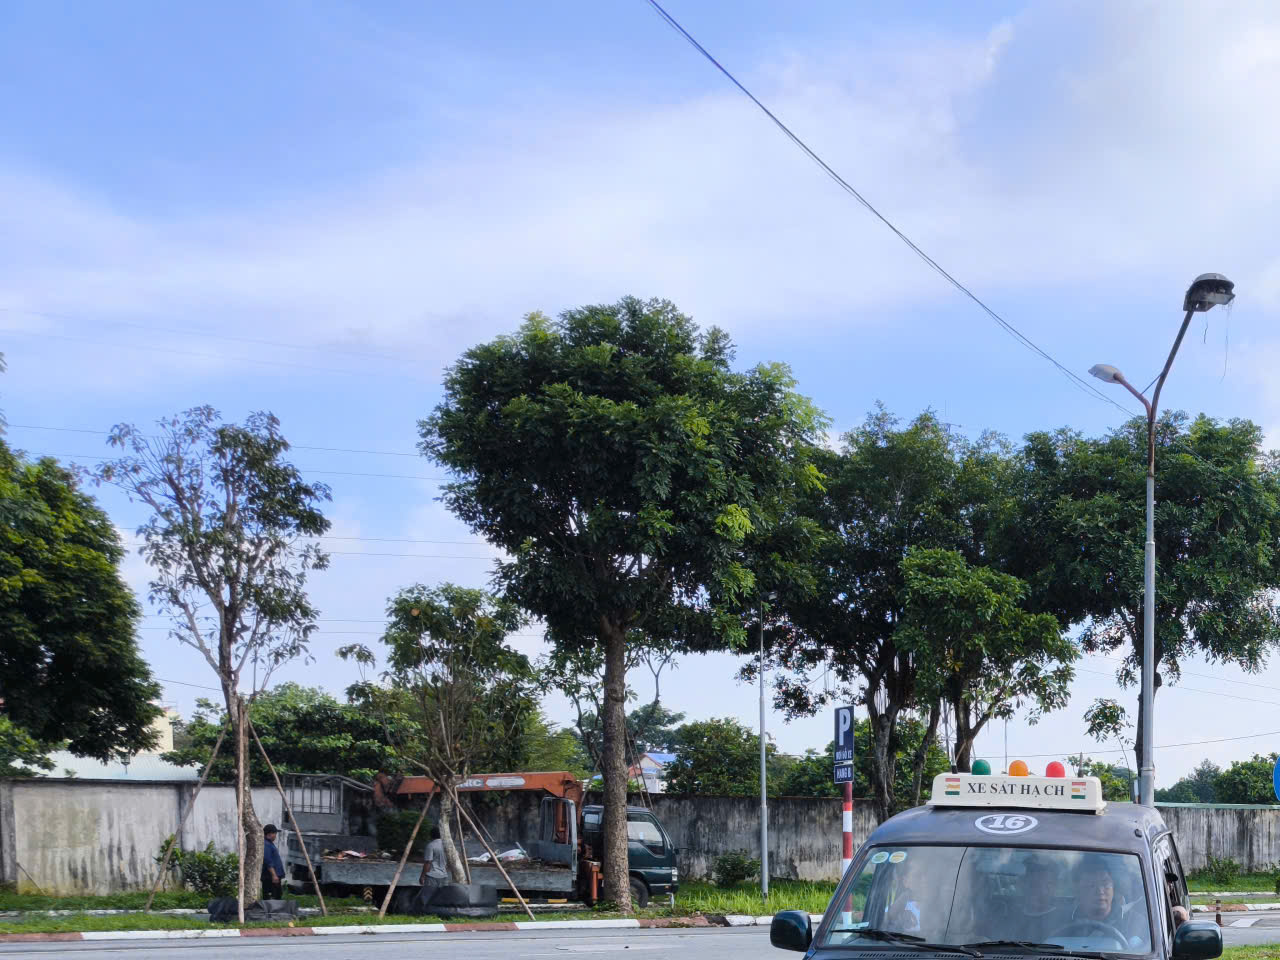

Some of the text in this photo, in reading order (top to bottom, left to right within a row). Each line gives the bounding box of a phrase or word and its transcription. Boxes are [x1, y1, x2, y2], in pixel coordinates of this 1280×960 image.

[839, 709, 850, 746] P
[967, 782, 987, 794] XE
[990, 780, 1016, 795] SÁT
[987, 815, 1026, 829] 16
